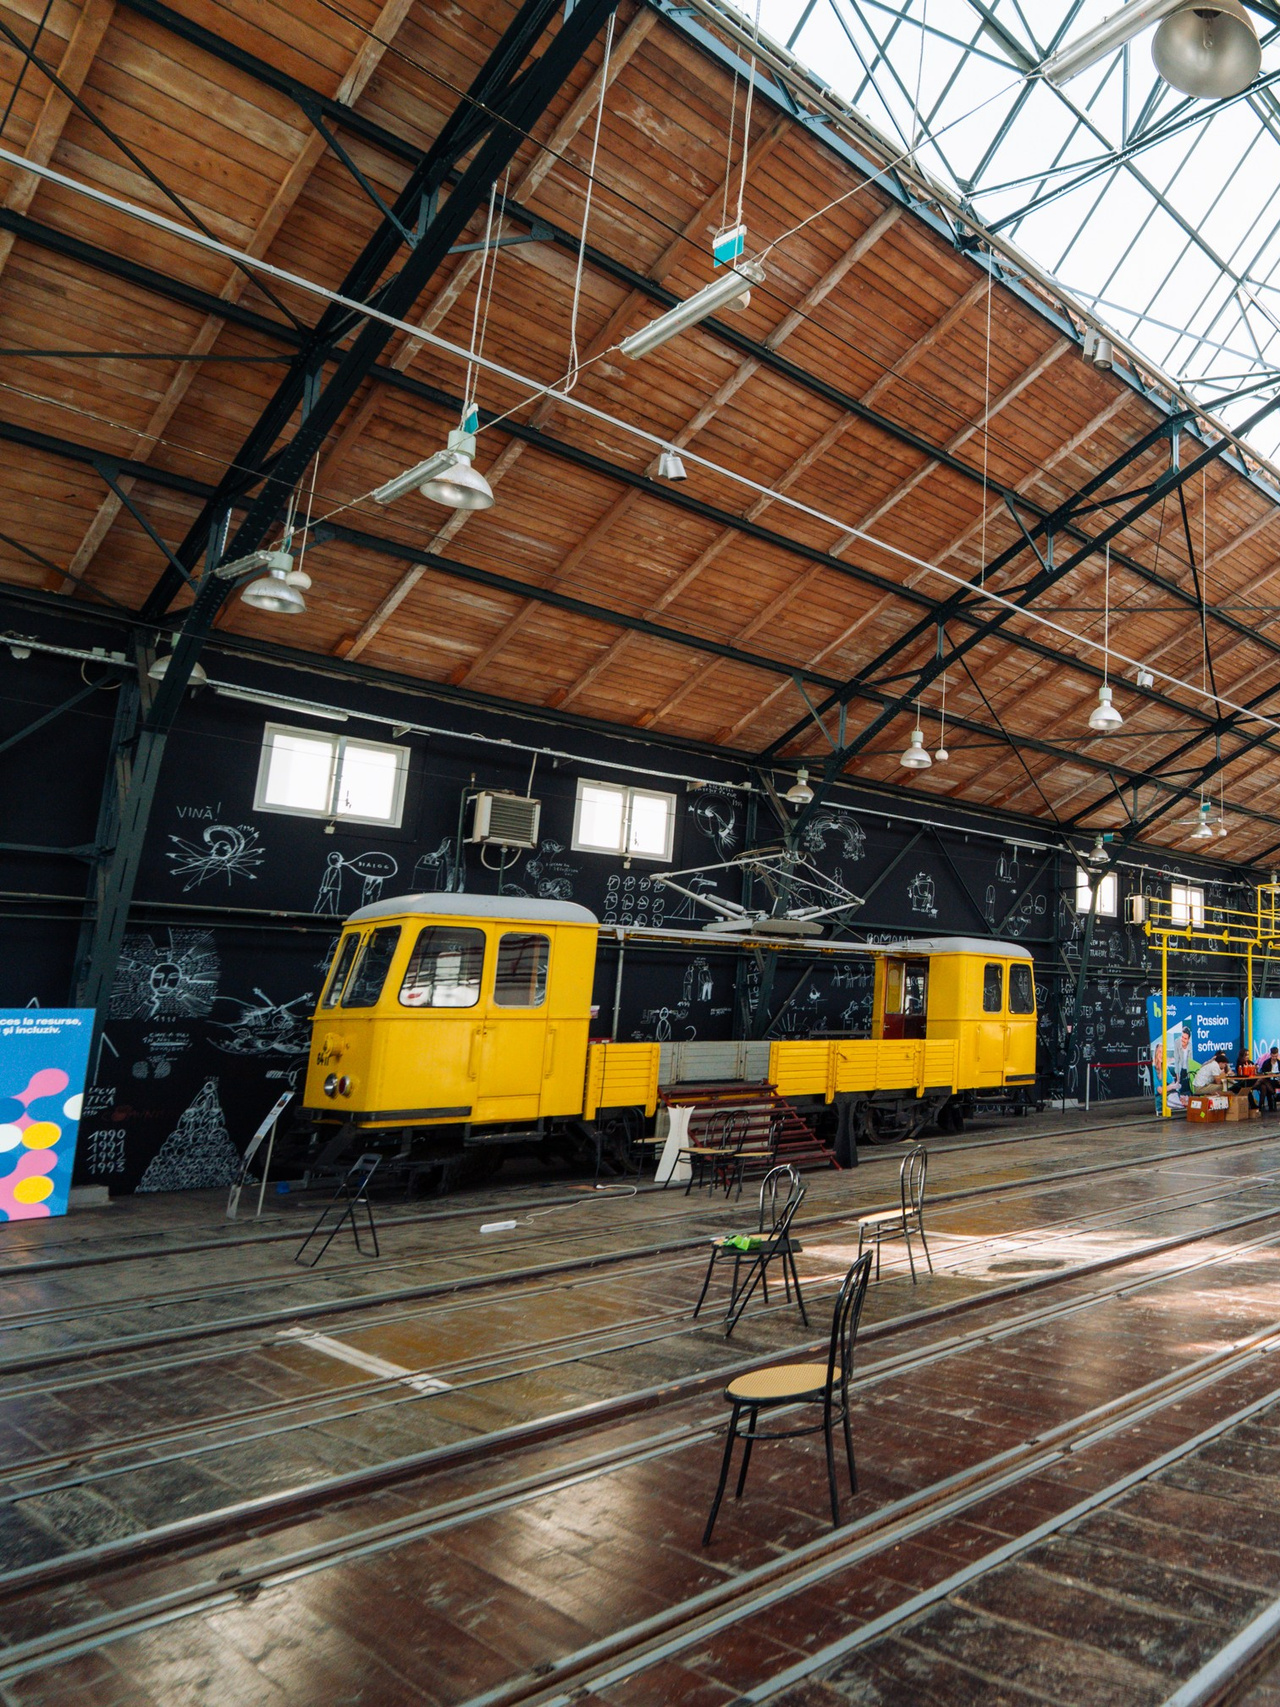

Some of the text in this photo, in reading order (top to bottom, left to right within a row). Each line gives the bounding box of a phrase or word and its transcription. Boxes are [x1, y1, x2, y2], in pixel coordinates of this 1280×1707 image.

[358, 861, 390, 870] DIALOG
[23, 1017, 34, 1026] la
[36, 1018, 82, 1027] resurse,
[1197, 1014, 1229, 1026] Passion
[15, 1026, 61, 1035] incluziv.
[1197, 1027, 1210, 1039] for
[1197, 1040, 1233, 1052] software
[88, 1128, 126, 1141] 1990
[87, 1140, 125, 1153] 1991
